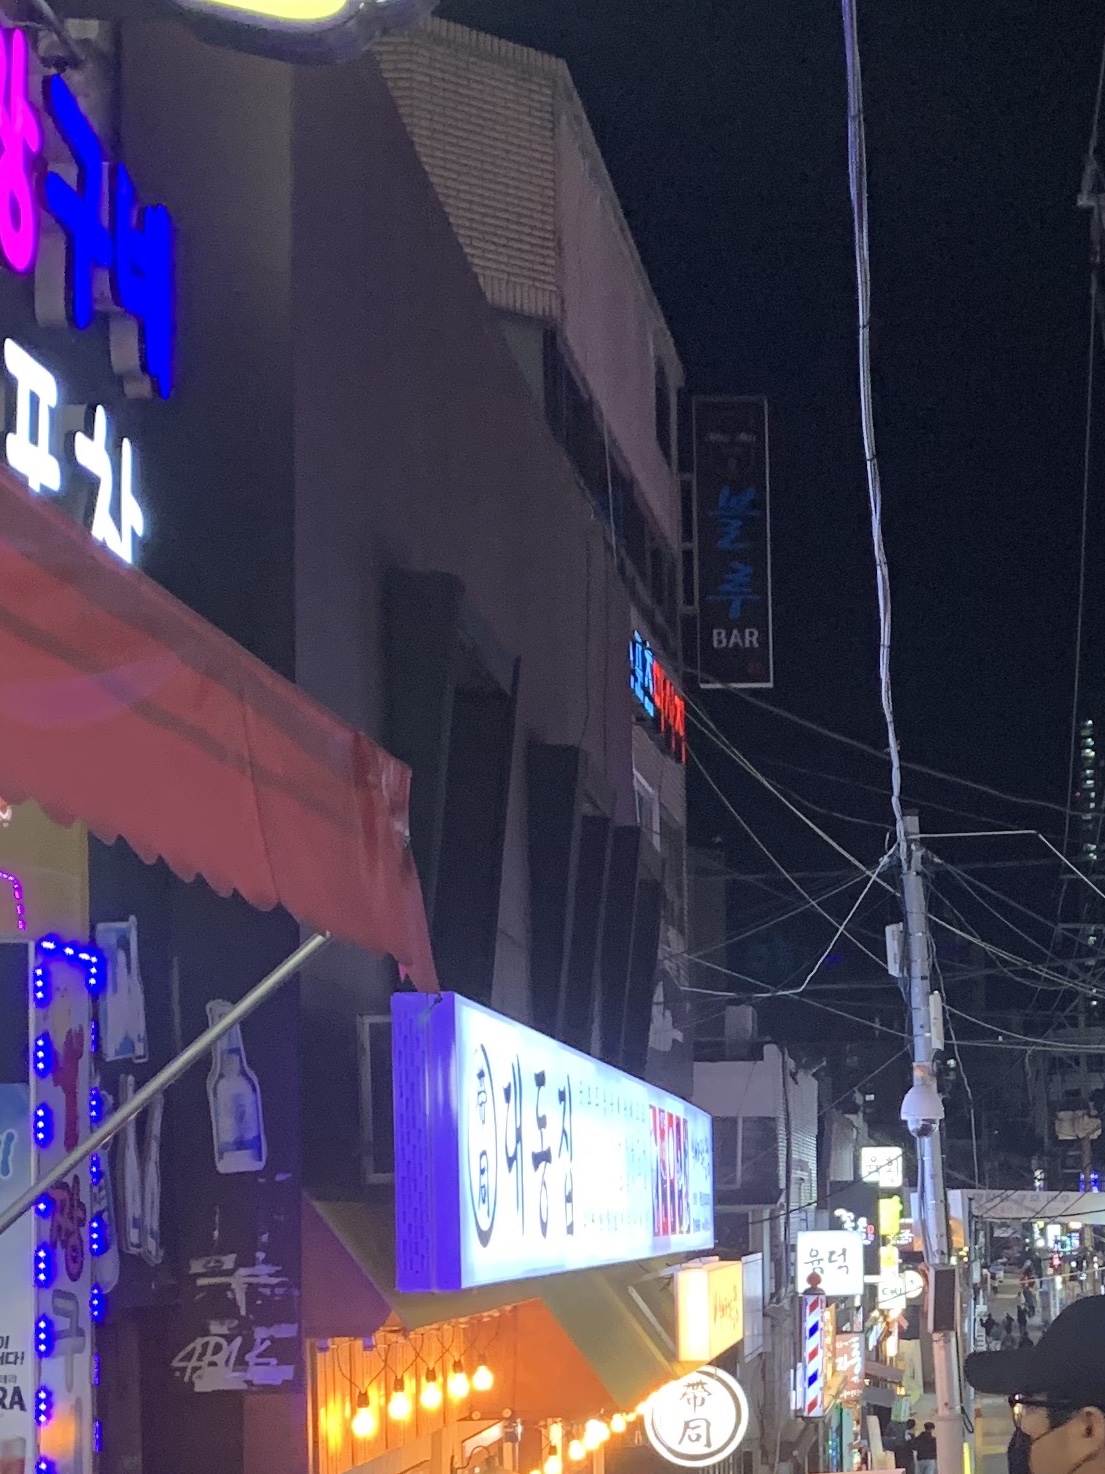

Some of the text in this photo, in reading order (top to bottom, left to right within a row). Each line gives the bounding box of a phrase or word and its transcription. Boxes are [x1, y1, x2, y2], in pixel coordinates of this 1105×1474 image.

[5, 337, 143, 564] 포차
[711, 627, 760, 650] BAR
[503, 1055, 575, 1239] 대동집
